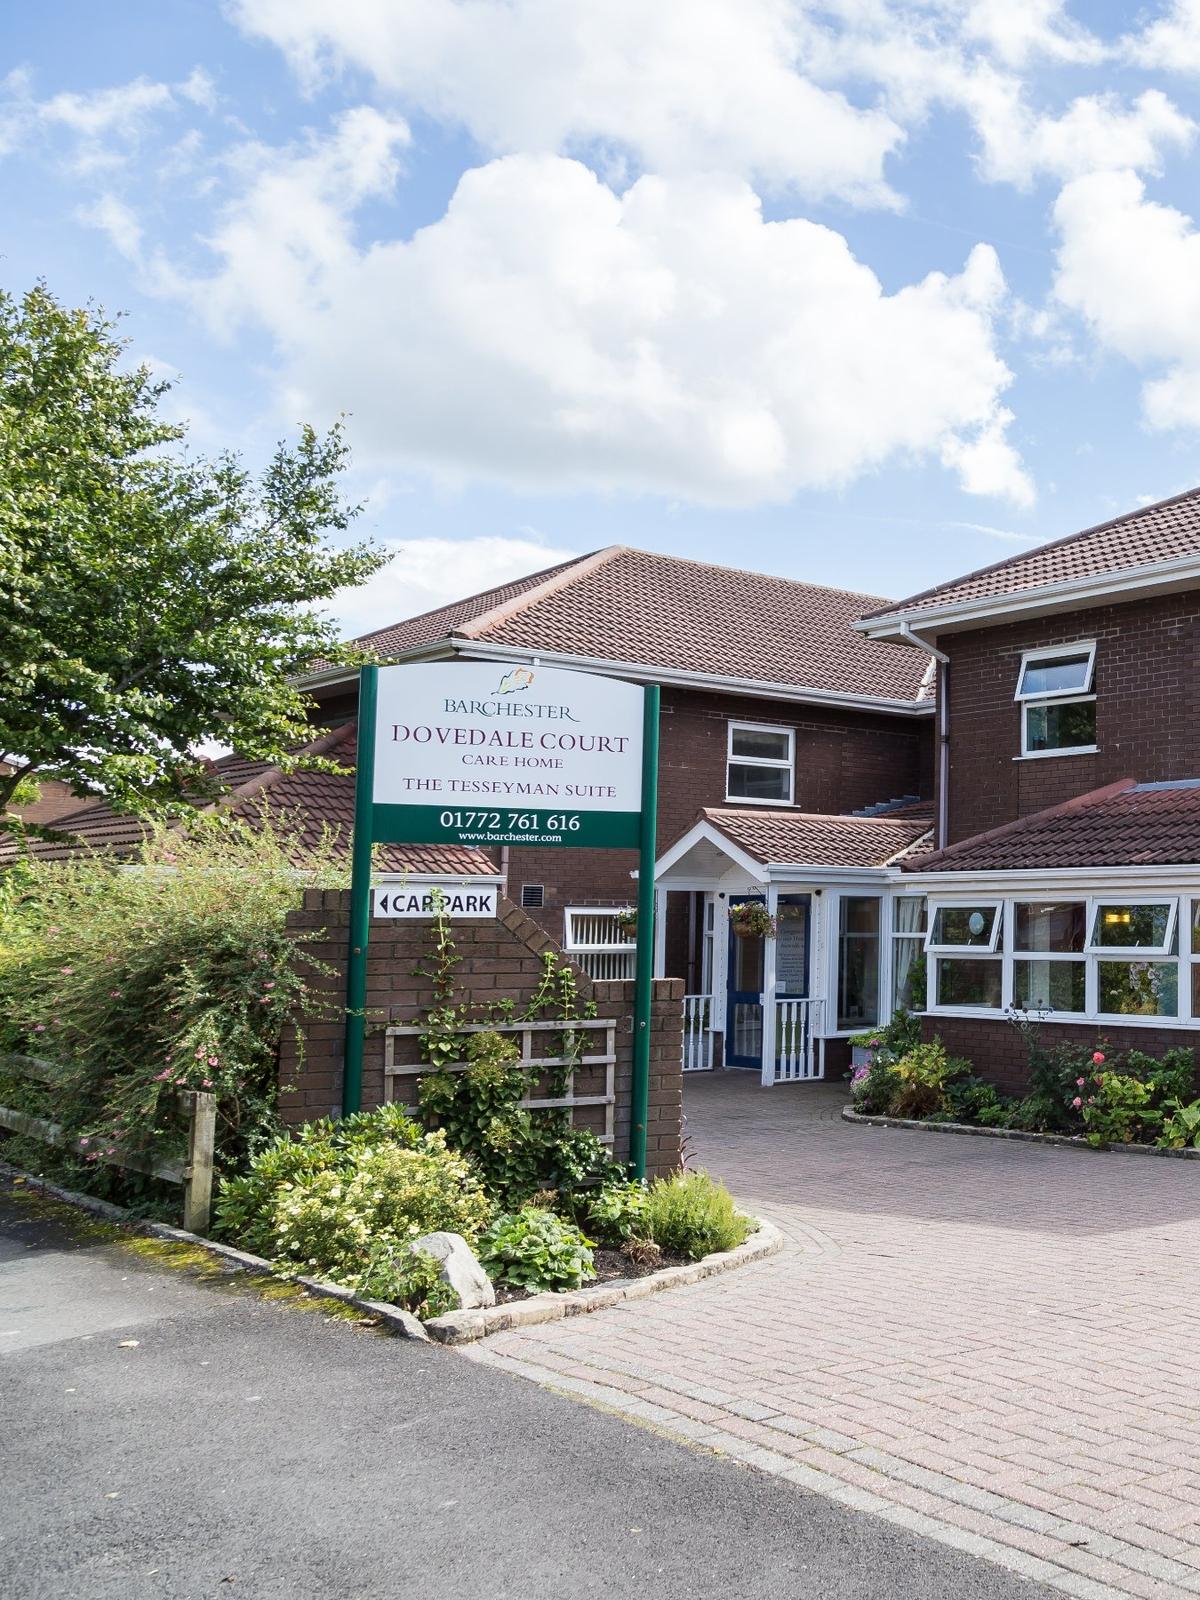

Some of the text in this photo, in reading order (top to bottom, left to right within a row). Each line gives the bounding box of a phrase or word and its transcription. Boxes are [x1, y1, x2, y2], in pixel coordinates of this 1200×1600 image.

[443, 698, 580, 722] BARCHESTER
[391, 724, 629, 753] DOVEDALE COURT
[461, 754, 564, 769] CARE HOME
[402, 777, 617, 798] THE TESSEYMAN SUITE
[440, 811, 580, 831] 01772 761 616
[458, 832, 562, 842] www.barchester.com
[392, 895, 434, 912] CAR
